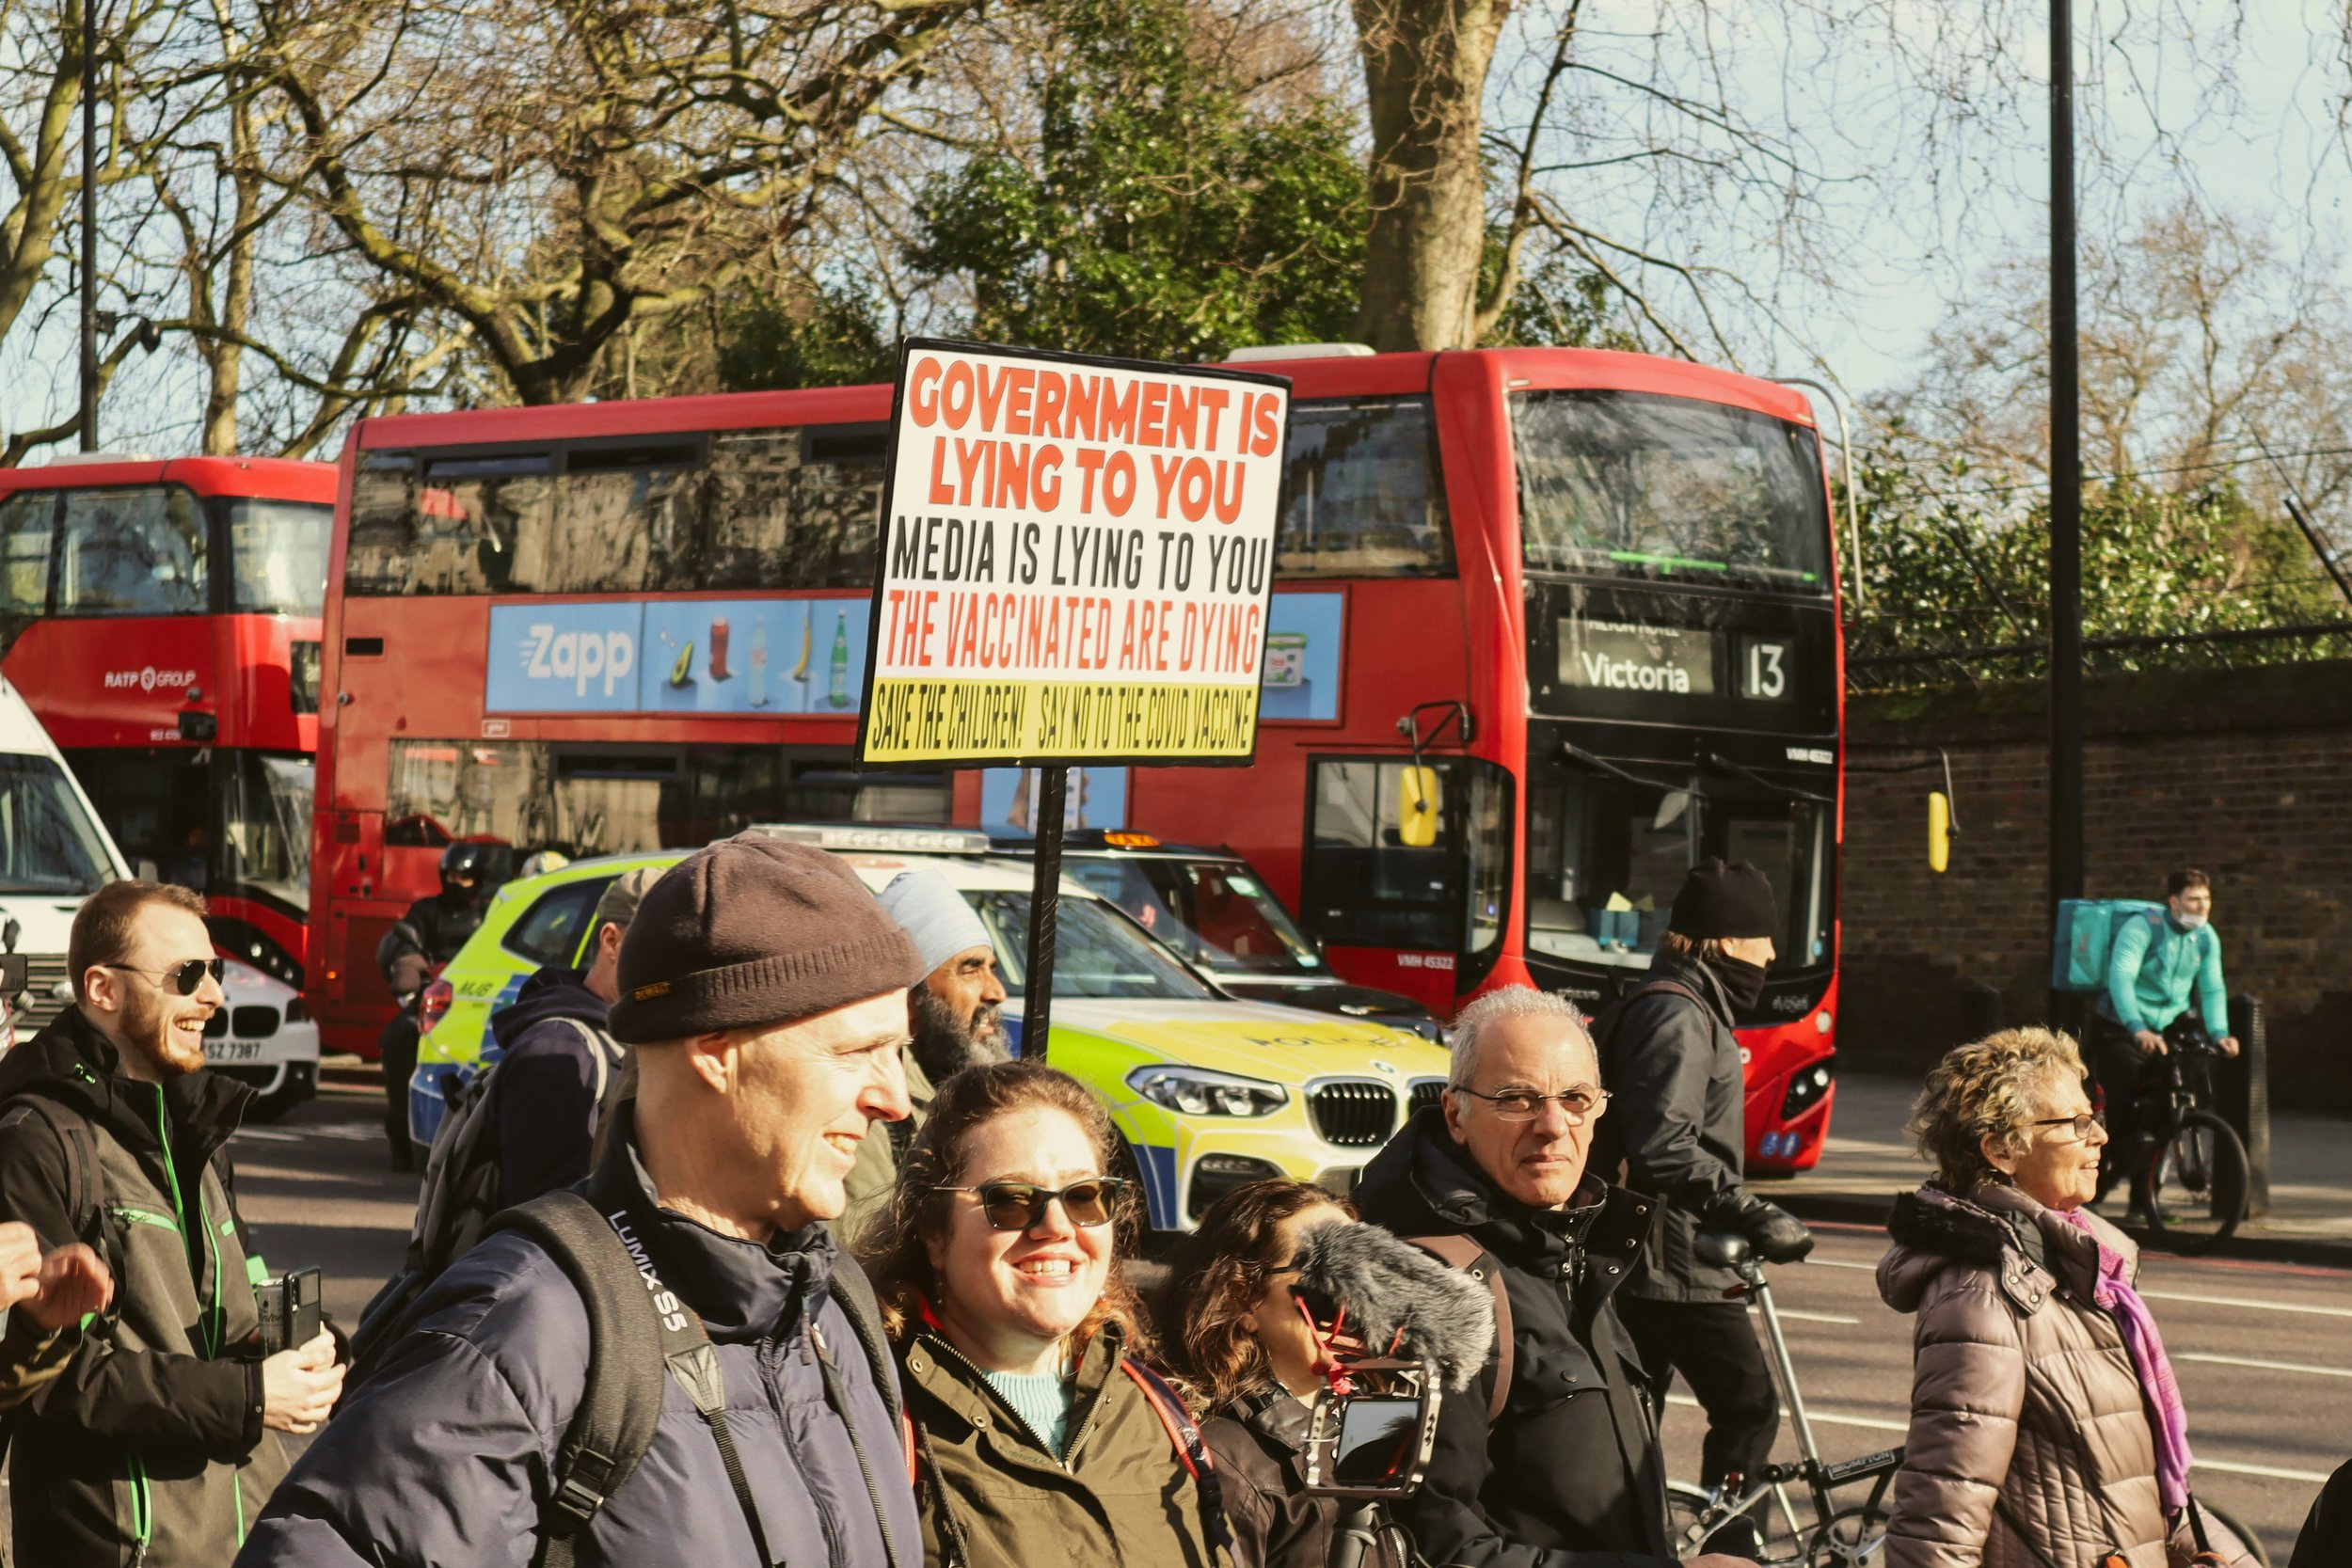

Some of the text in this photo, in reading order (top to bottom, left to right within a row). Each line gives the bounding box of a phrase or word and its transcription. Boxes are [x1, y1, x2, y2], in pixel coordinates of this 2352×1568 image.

[909, 356, 1280, 457] GOVERNMENT IS
[929, 436, 1247, 525] LYING TO YOU
[890, 515, 1268, 596] MEDIA IS LYING TO YOU
[522, 623, 634, 698] Zapp
[885, 589, 1261, 675] THE VACCINATED ARE DYING
[104, 670, 197, 689] RATP GROUP
[1581, 650, 1691, 694] Victoria
[1750, 642, 1786, 698] 13
[871, 683, 1252, 751] SAVE THE CHILDREN! SAY NO TO THE COVID VACCINE
[201, 1042, 226, 1060] SZ
[608, 1210, 689, 1332] LUMIX S5
